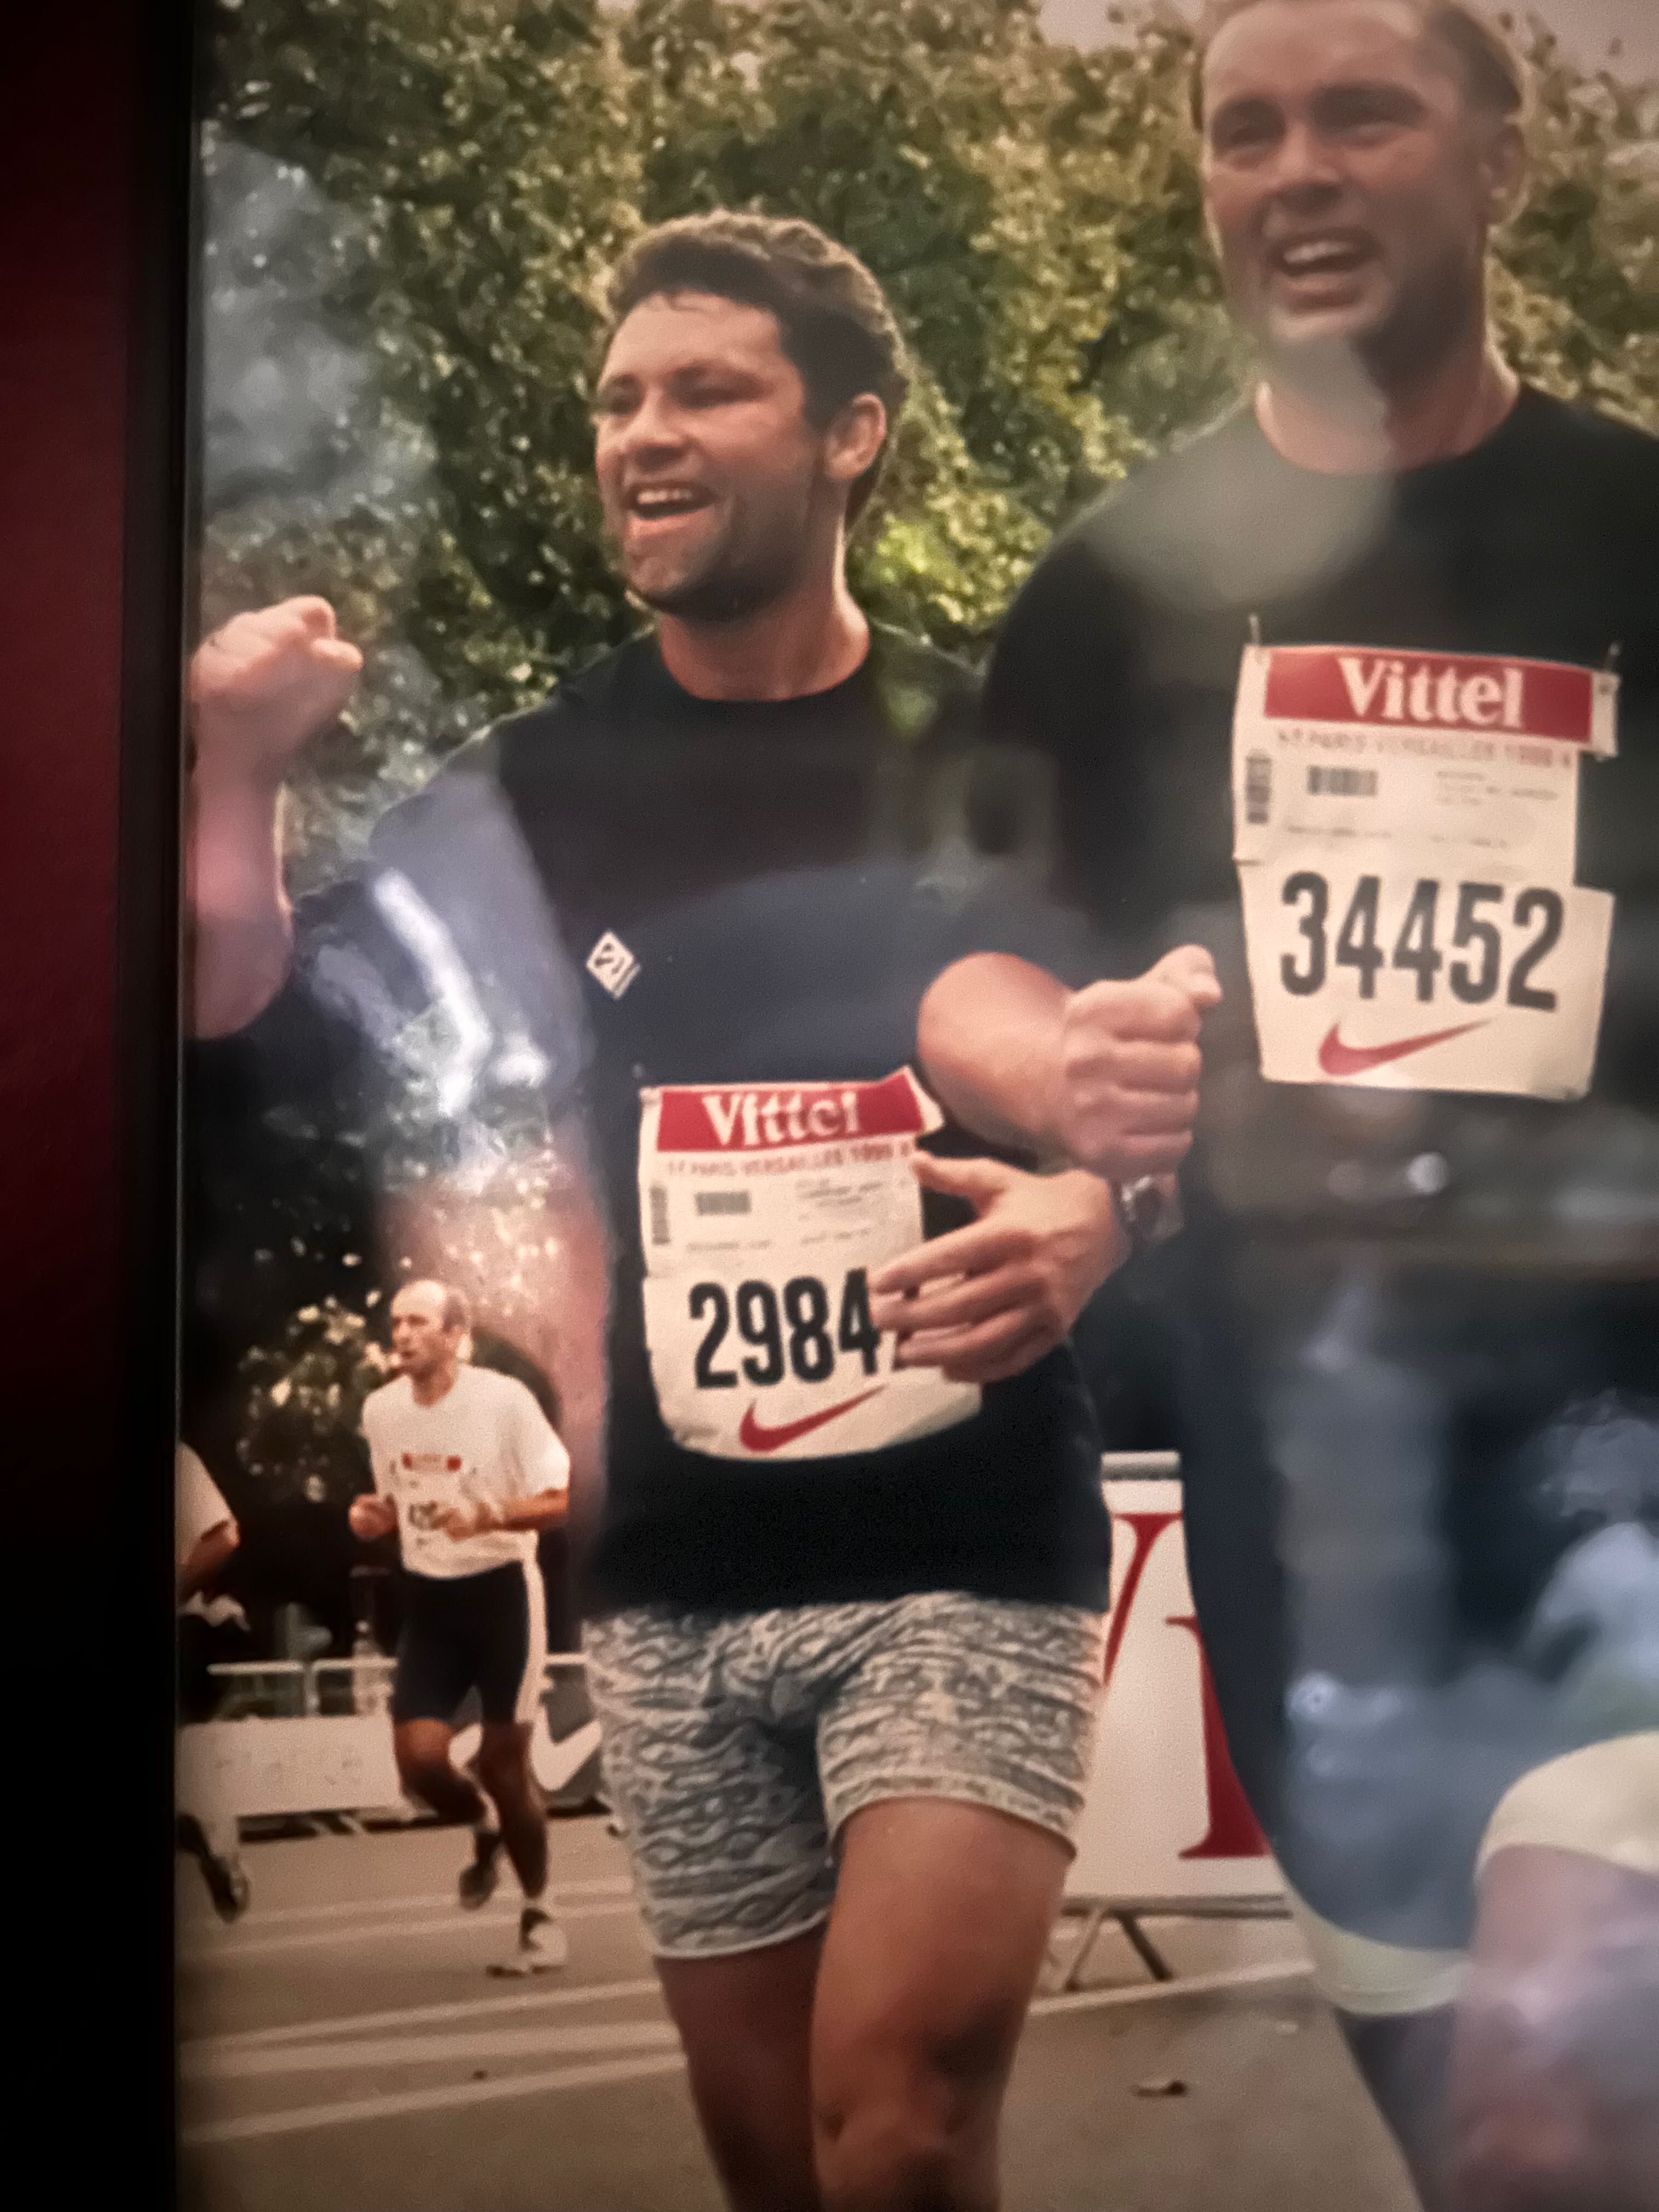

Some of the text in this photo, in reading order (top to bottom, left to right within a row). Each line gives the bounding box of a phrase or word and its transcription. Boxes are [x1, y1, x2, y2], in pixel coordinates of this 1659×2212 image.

[1337, 657, 1524, 727] Vittel
[1279, 871, 1565, 1013] 34452
[702, 1092, 860, 1146] Vittel
